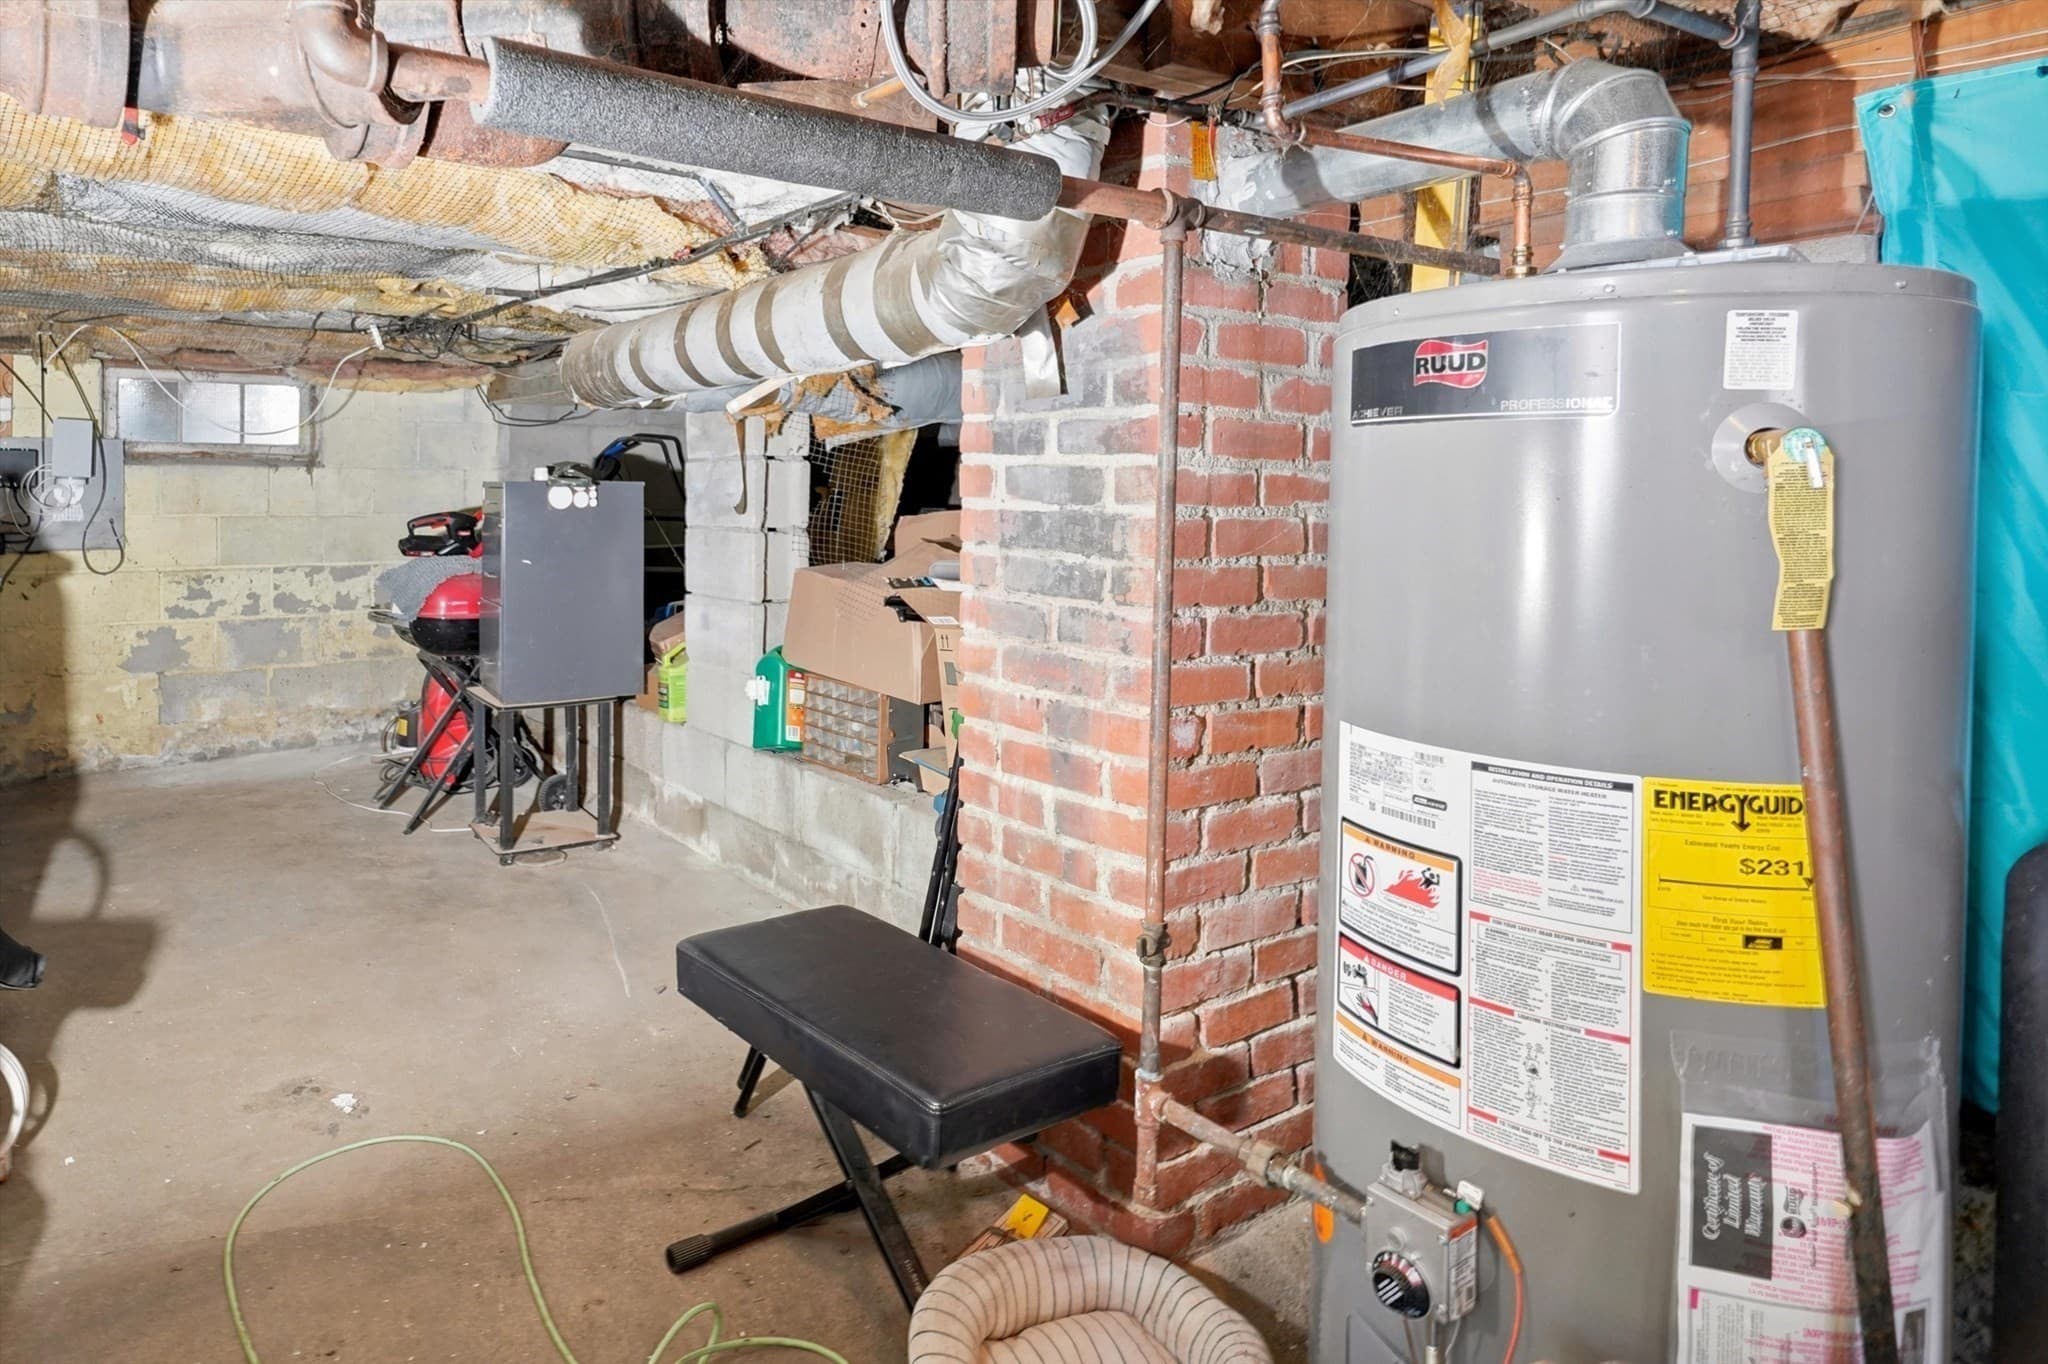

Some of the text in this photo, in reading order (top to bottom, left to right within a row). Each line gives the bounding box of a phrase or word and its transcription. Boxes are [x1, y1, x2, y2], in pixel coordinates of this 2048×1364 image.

[1415, 353, 1487, 375] RUUD
[1653, 789, 1805, 824] ENERGYGUID
[1374, 839, 1416, 861] WARNING
[1739, 857, 1805, 877] $231
[1370, 957, 1408, 981] DANGER
[1371, 1038, 1410, 1066] WARNING
[1702, 1151, 1726, 1240] Certificate of
[1722, 1173, 1741, 1230] Limited
